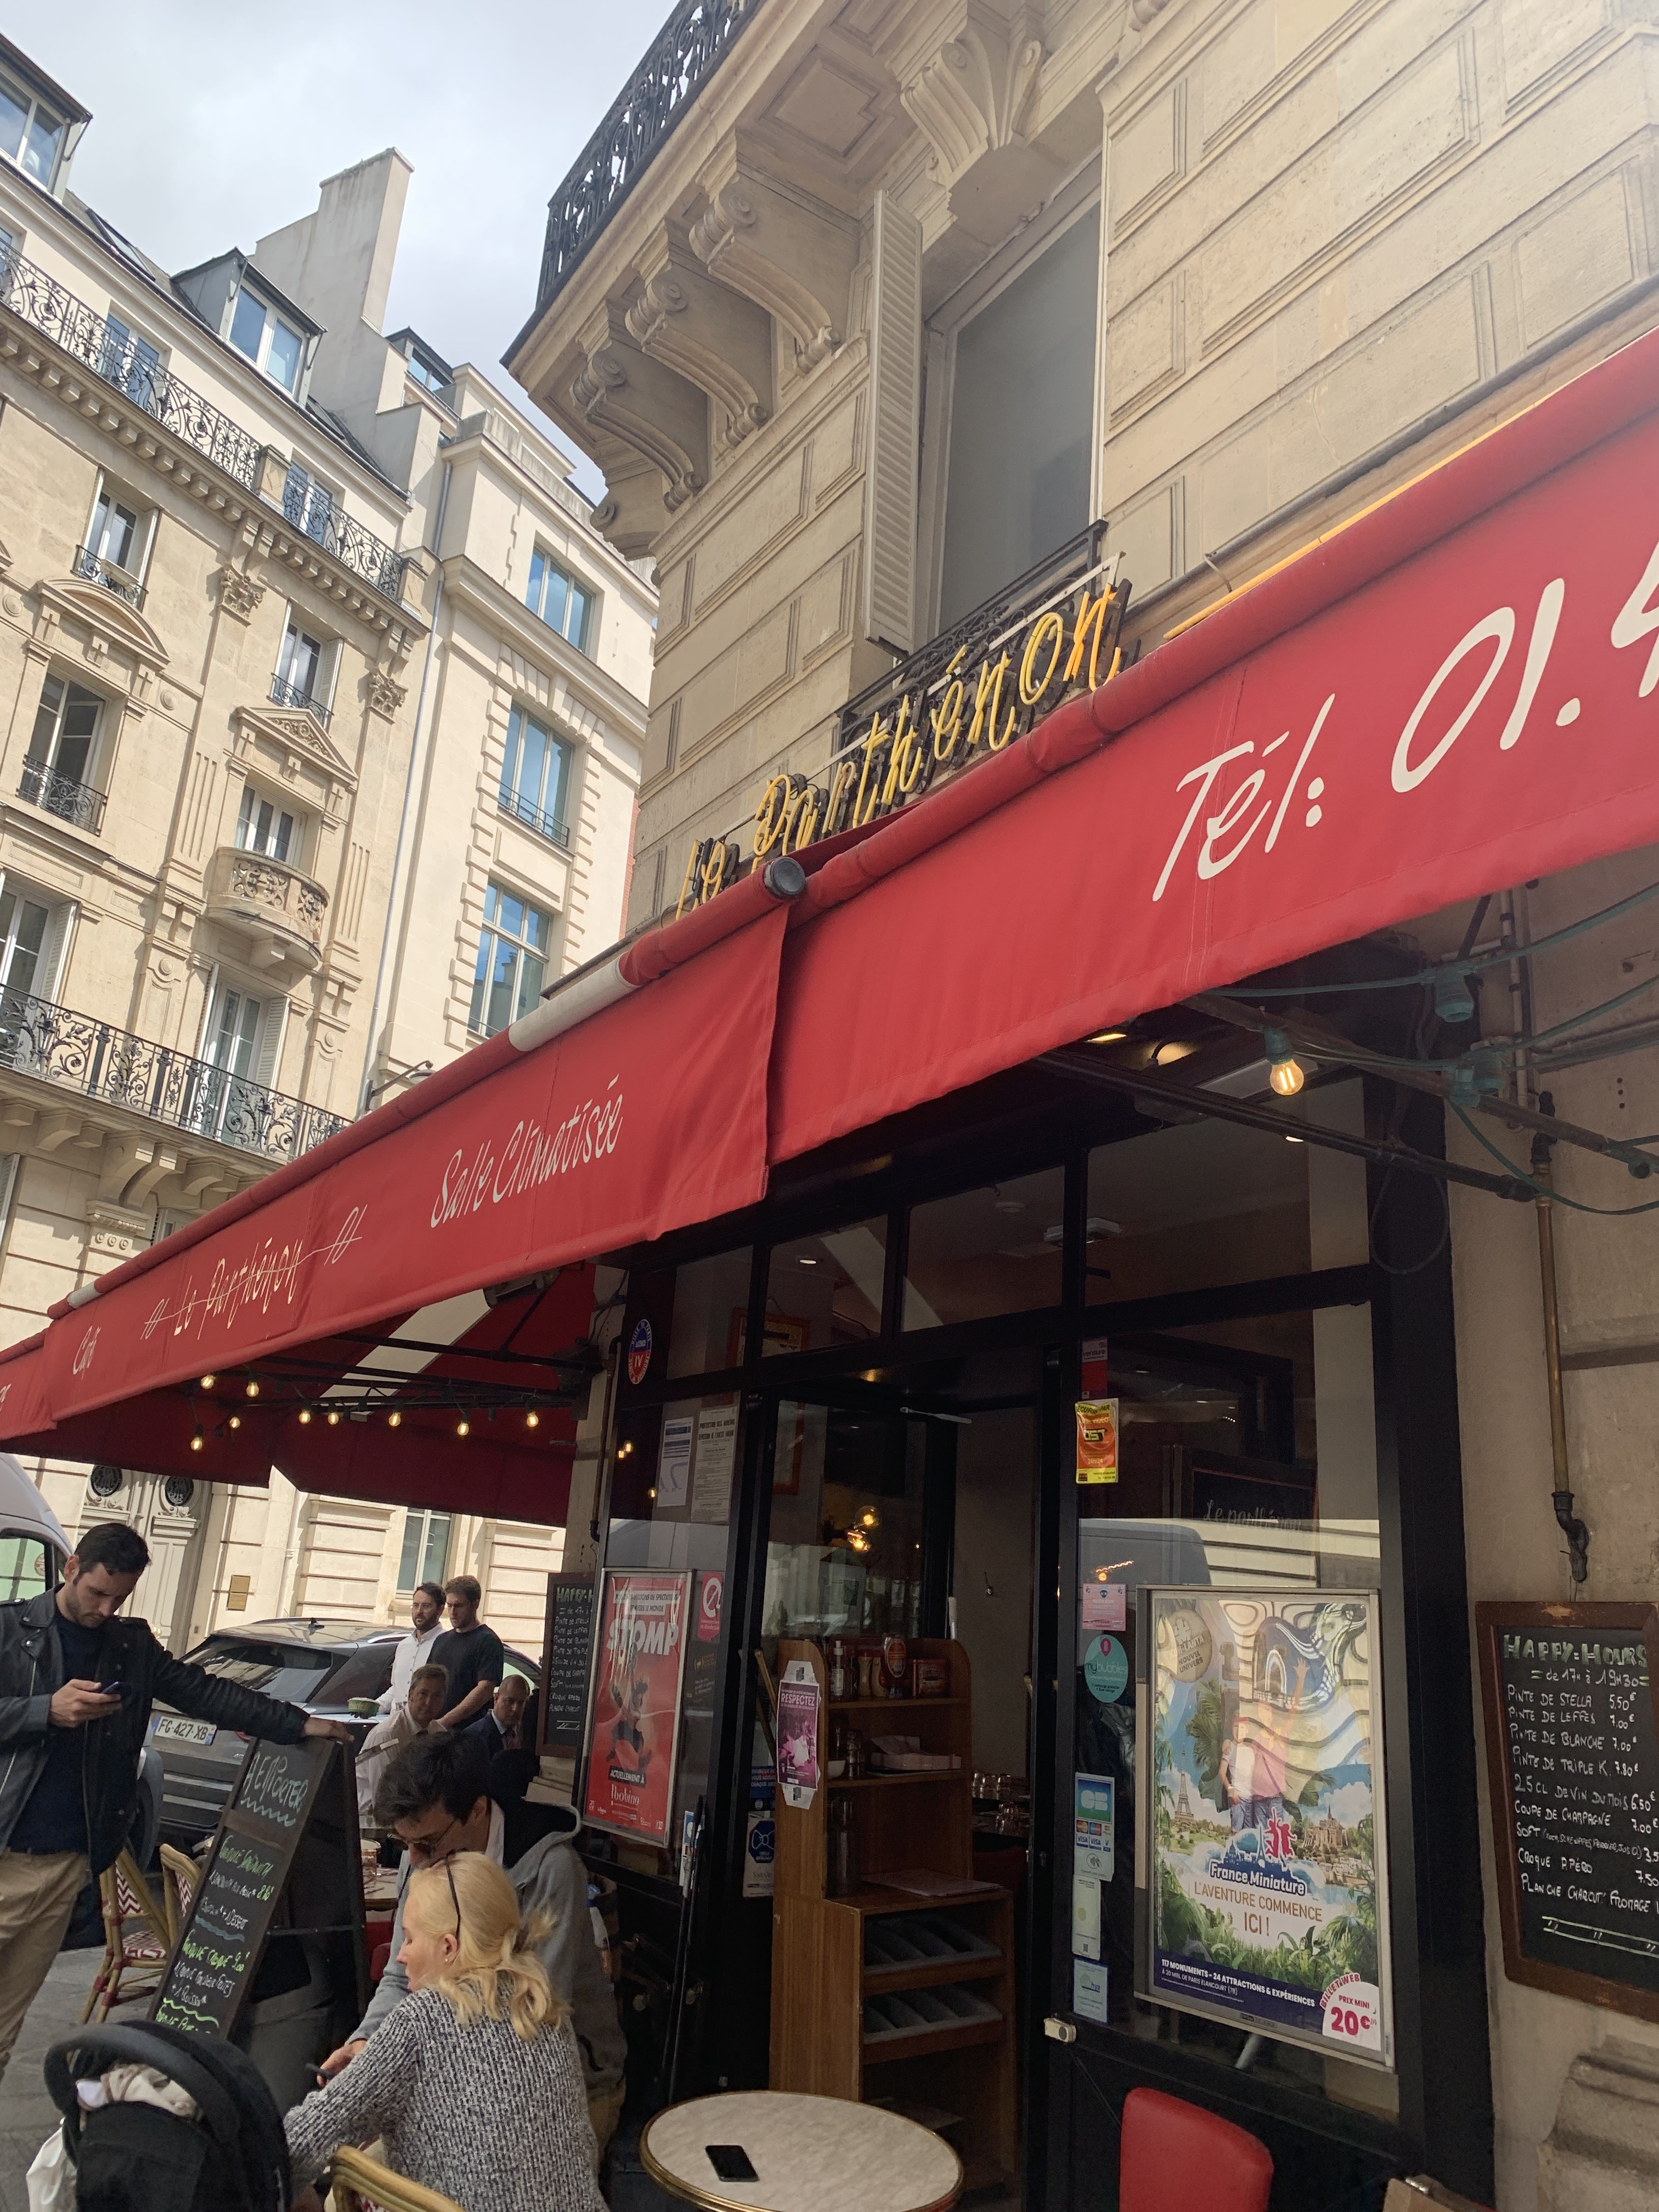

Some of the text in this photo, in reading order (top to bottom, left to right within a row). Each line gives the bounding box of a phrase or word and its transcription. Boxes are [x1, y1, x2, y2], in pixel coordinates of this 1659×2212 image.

[431, 1074, 623, 1228] Salle Climatisée
[606, 1618, 679, 1656] STOMP
[1178, 1650, 1200, 1666] NOUVEL
[1180, 1657, 1204, 1673] UNIVERS
[781, 1693, 815, 1706] RESPECTEZ
[1541, 1694, 1554, 1706] DE
[1560, 1692, 1592, 1707] STELLA
[1542, 1711, 1555, 1723] DE
[1542, 1731, 1555, 1746] DE
[1561, 1731, 1605, 1750] BLANCHE
[1542, 1757, 1555, 1771] DE
[610, 1770, 640, 1783] ACTUELLEMENT
[1555, 1785, 1568, 1798] DE
[1515, 1800, 1542, 1818] COUPE
[1545, 1808, 1558, 1820] DE
[1562, 1807, 1611, 1826] CHAMPAGNE
[1516, 1822, 1541, 1837] SOFT
[1210, 1863, 1306, 1895] France Miniature
[1194, 1881, 1323, 1922] L'AVENTURE COMMENCE
[1161, 1959, 1170, 1967] 117
[1170, 1962, 1209, 1978] MONUMENTS
[1213, 1972, 1221, 1982] 24
[1221, 1976, 1266, 1993] ATTRACTIONS
[1272, 1990, 1315, 2007] EXPÉRIENCES
[1188, 1976, 1200, 1985] PARIS
[1321, 1974, 1360, 2008] BILLET WEB
[1339, 1995, 1370, 2009] PRIX MINI
